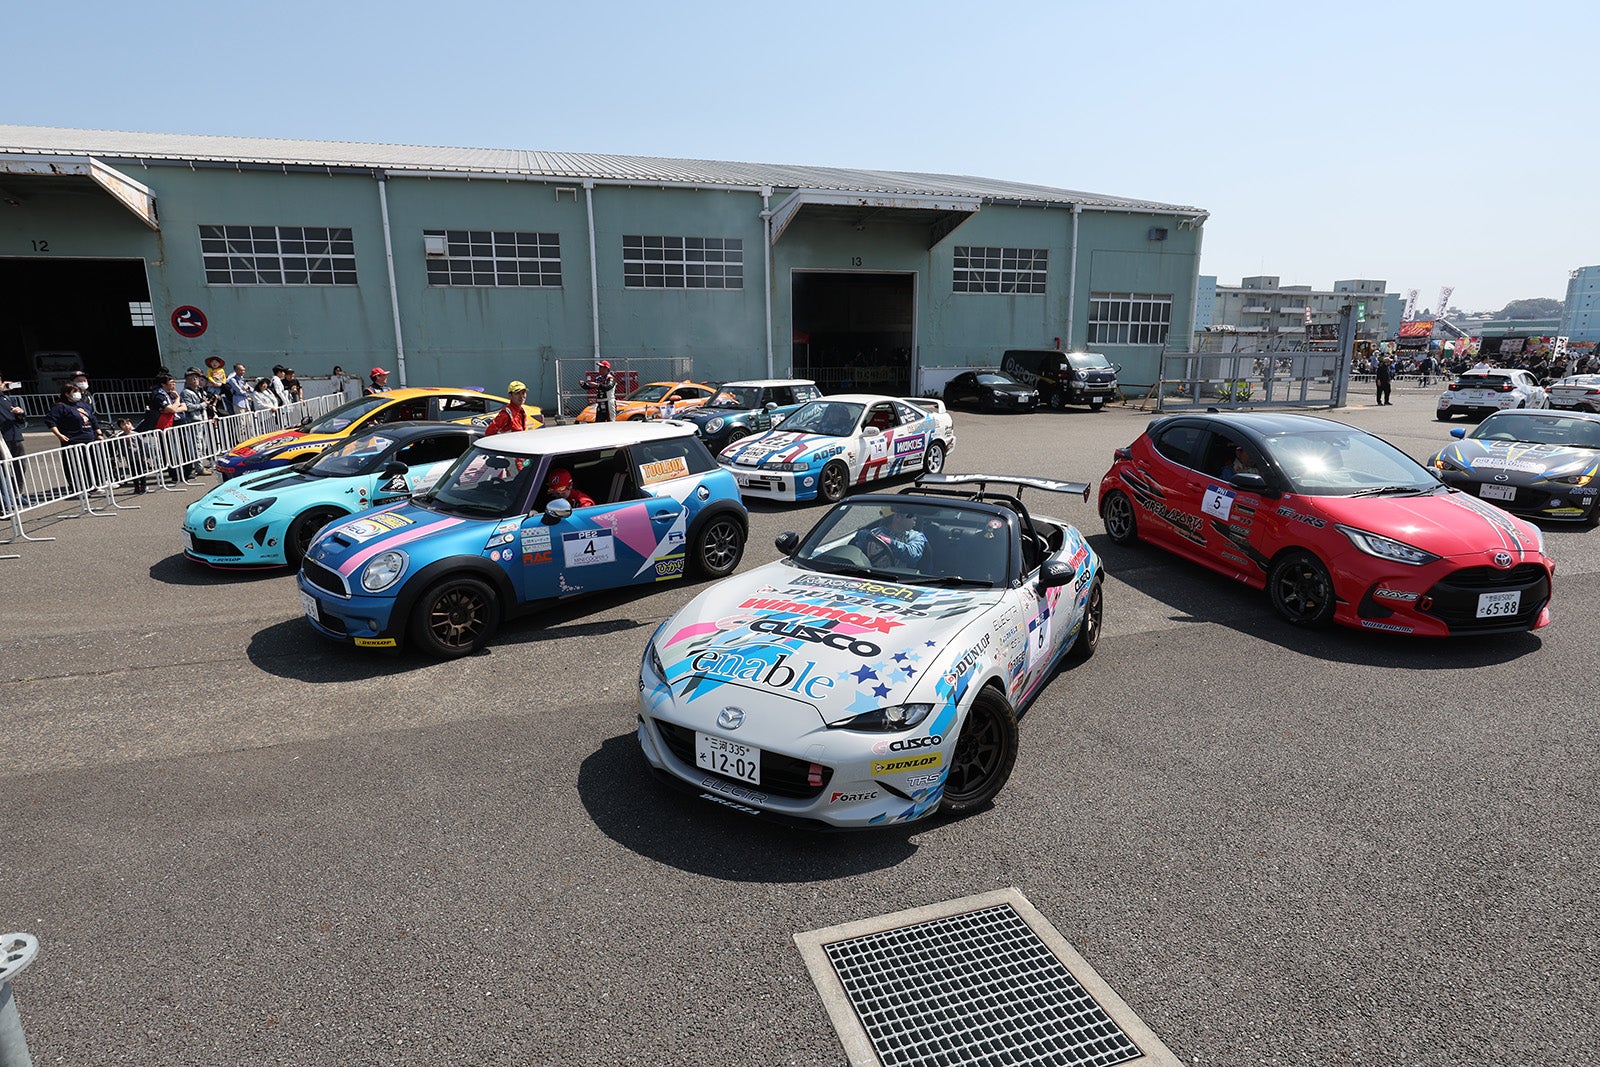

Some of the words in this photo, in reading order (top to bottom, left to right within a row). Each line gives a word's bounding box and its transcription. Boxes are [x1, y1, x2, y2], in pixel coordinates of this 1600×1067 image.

[31, 239, 50, 252] 12
[851, 256, 863, 267] 13
[642, 457, 685, 478] TOOLBOX
[1213, 496, 1222, 510] 5
[578, 530, 598, 539] PE2
[584, 540, 596, 555] 4
[1376, 589, 1419, 600] RAYS
[781, 588, 928, 617] DUNLOP
[1486, 601, 1517, 616] 65-88
[1038, 627, 1044, 649] 6
[956, 632, 991, 676] DUNLOP
[688, 650, 835, 700] enable
[889, 735, 942, 752] CUSCO
[711, 751, 757, 782] 12-02
[885, 756, 938, 771] DUNLOP
[829, 791, 878, 804] FORTEC
